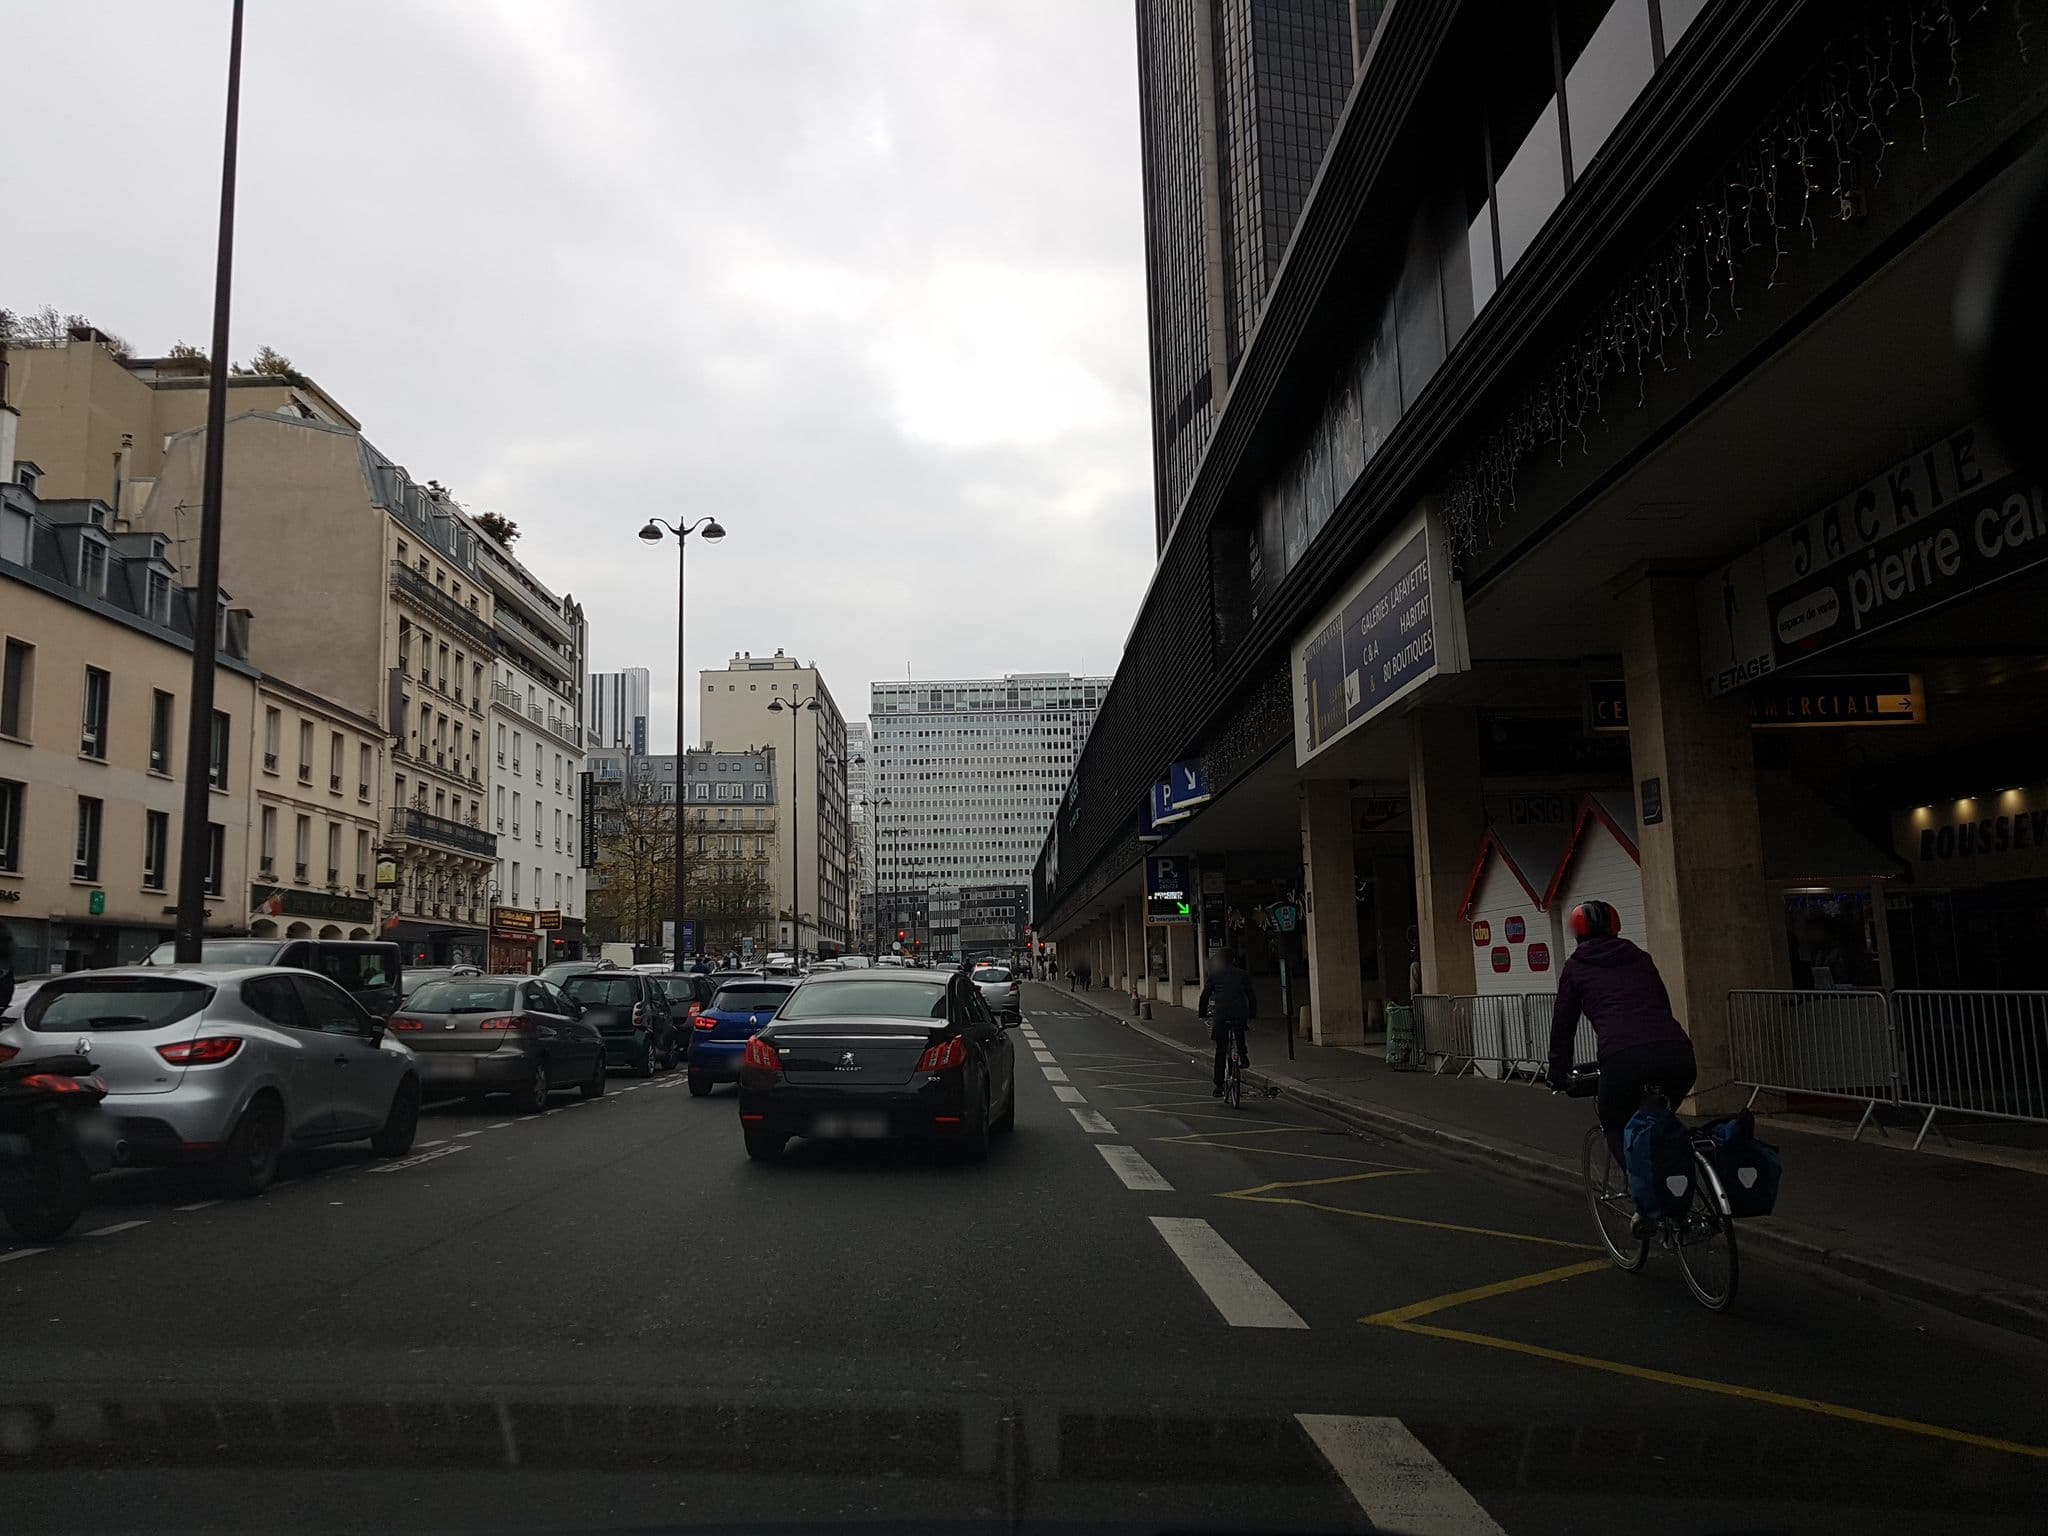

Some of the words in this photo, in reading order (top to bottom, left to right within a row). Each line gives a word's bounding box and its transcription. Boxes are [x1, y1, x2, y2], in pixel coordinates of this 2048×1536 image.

[1792, 428, 1984, 576] JACKIE
[1361, 596, 1389, 635] GALERIES
[1390, 560, 1428, 609] LAFAYETTE
[1847, 528, 1961, 631] pierre
[1399, 594, 1430, 635] HABITAT
[1382, 661, 1392, 683] 80
[1392, 629, 1433, 676] BOUTIQUES
[1719, 654, 1771, 689] ETAGE
